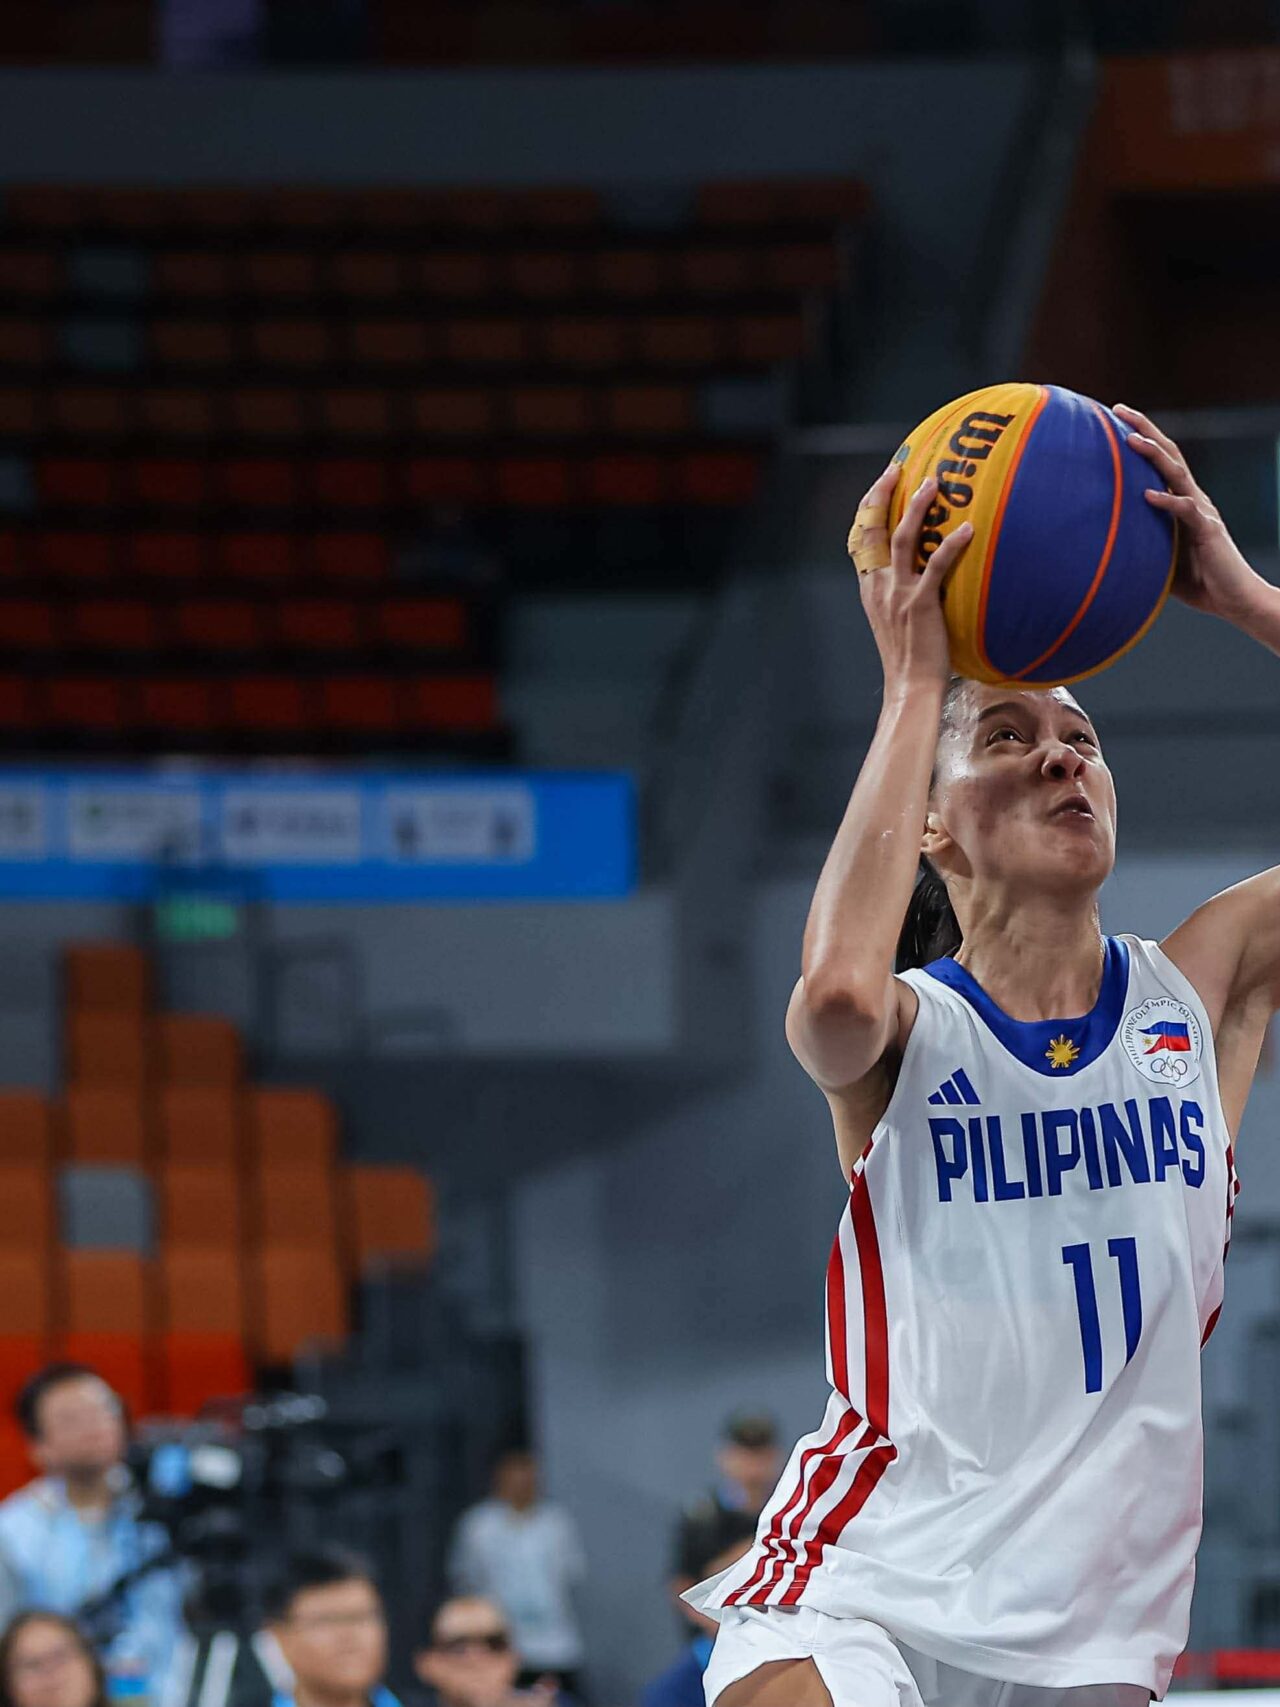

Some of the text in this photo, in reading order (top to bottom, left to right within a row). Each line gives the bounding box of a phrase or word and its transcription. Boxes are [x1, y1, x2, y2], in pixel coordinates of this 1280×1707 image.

[911, 411, 1017, 576] Wilso
[1134, 999, 1178, 1020] OLYMPIC
[927, 1096, 1206, 1203] PILIPINAS
[1061, 1236, 1143, 1394] 11
